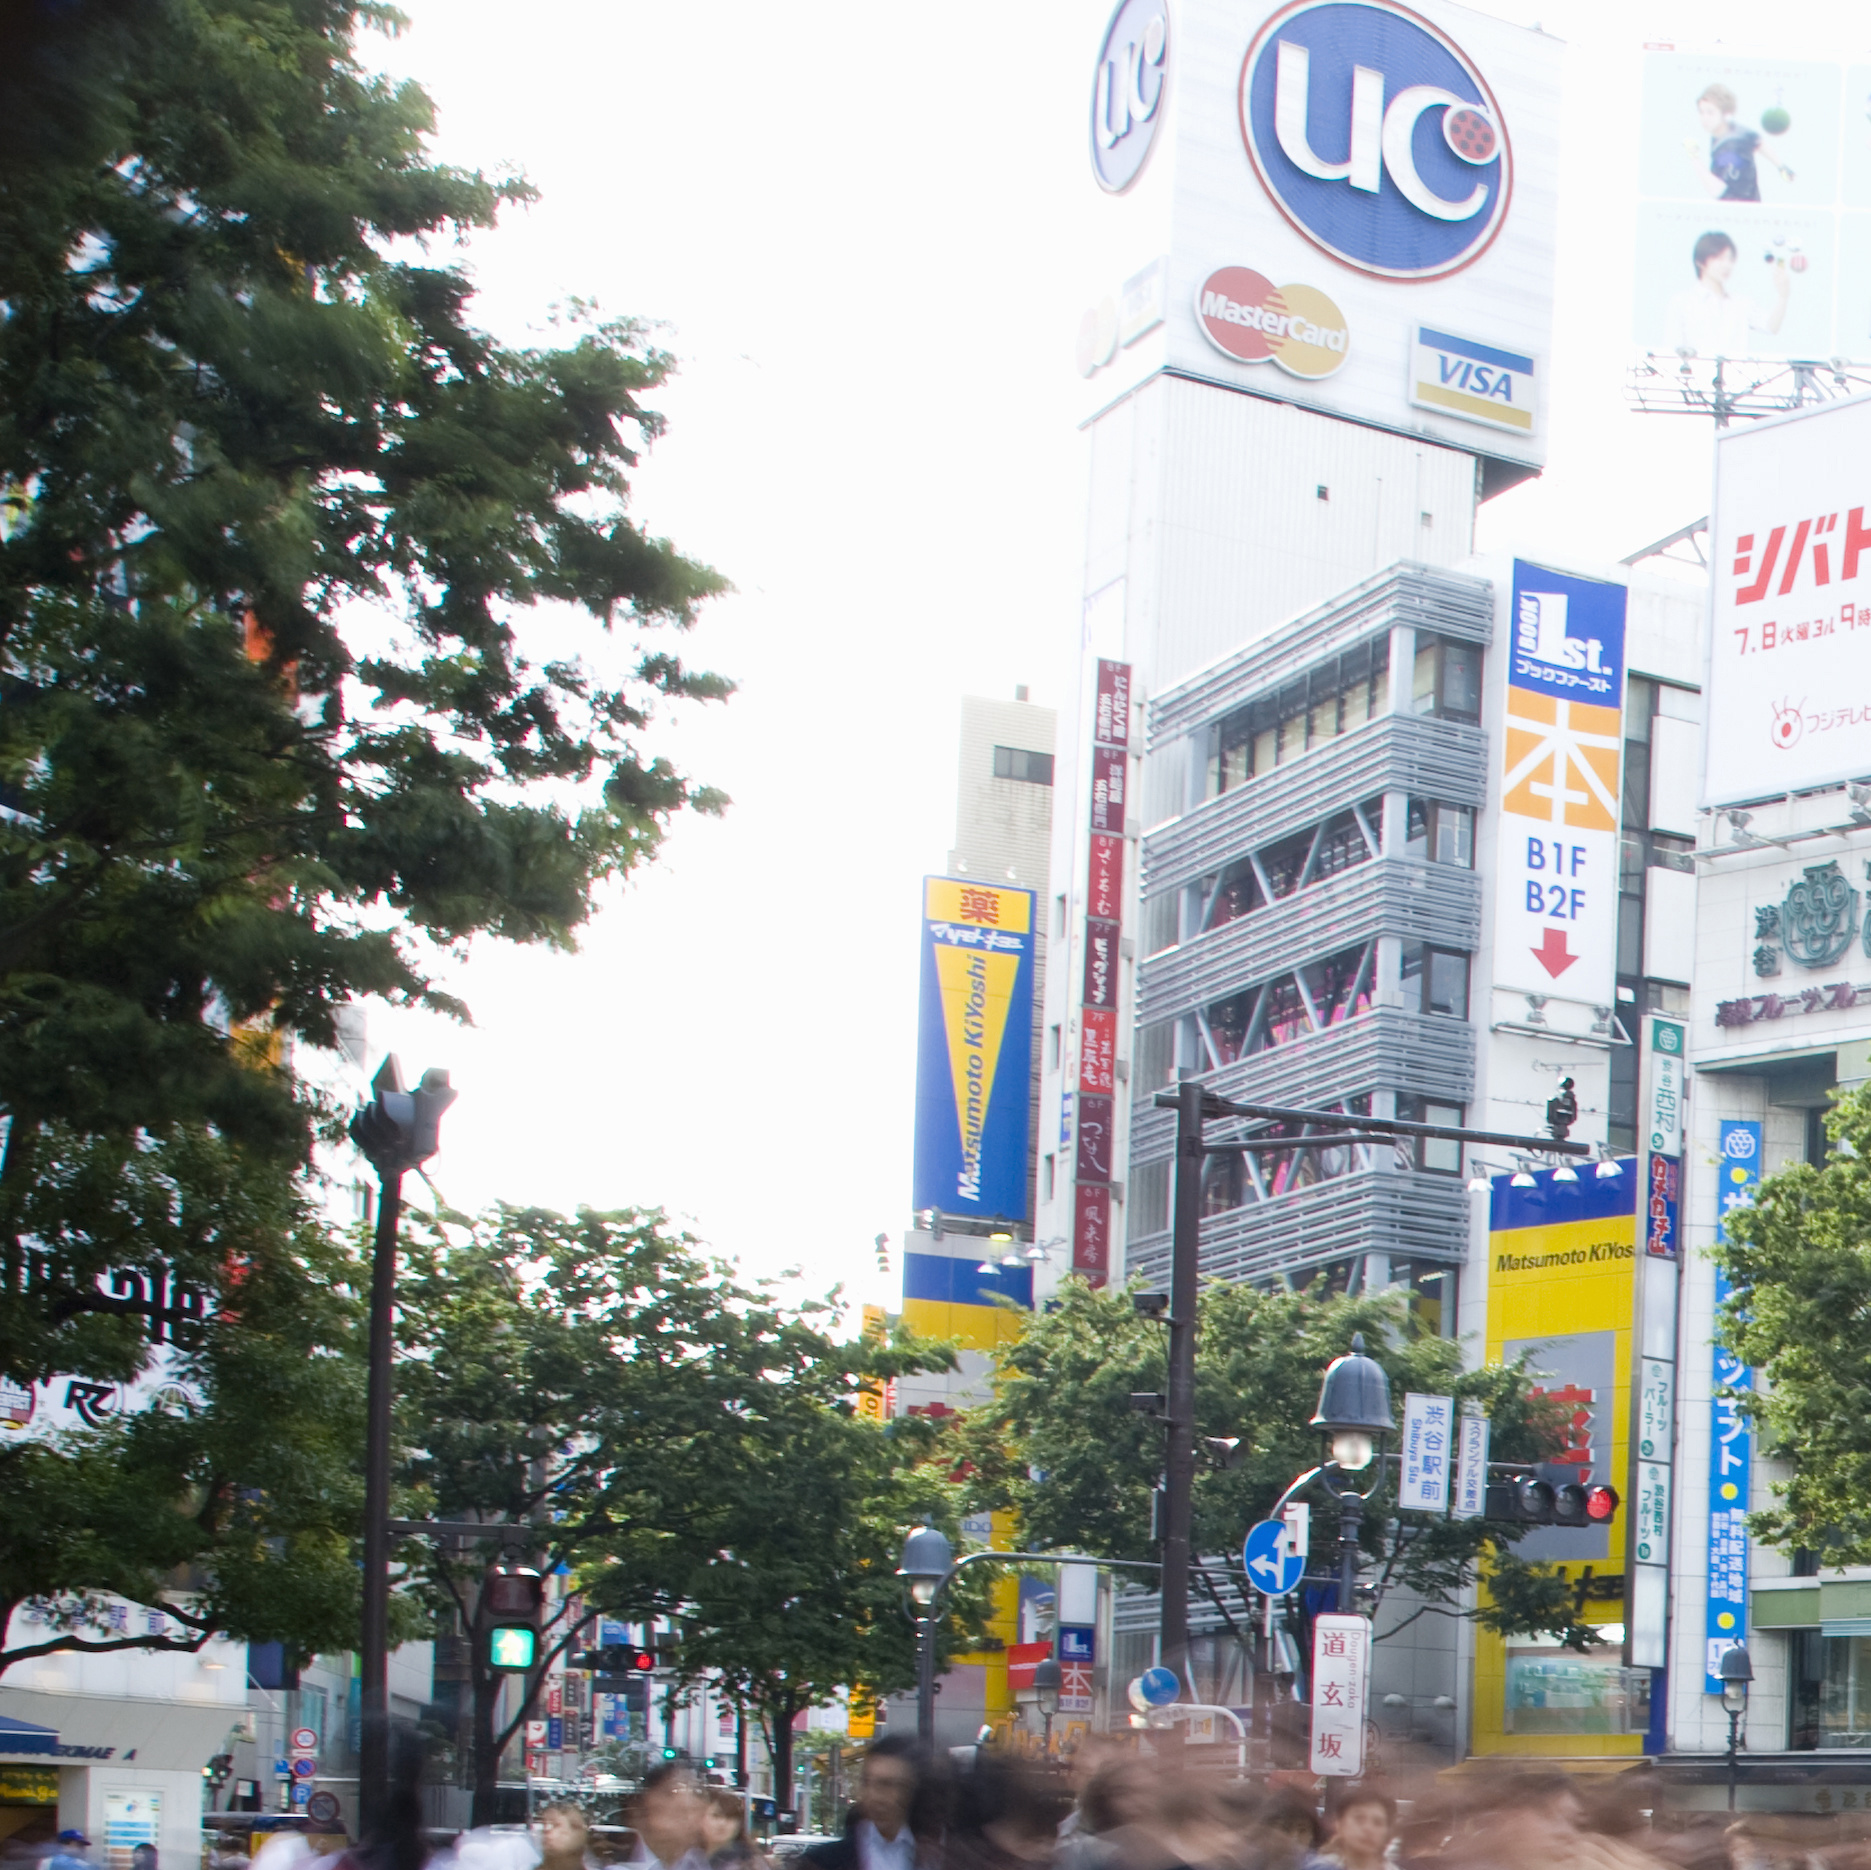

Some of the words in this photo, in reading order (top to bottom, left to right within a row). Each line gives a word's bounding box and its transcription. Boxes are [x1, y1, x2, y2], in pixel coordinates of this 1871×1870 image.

[1100, 15, 1166, 150] UC
[1274, 39, 1501, 222] UC
[1200, 290, 1348, 354] MasterCard
[1437, 354, 1514, 402] VISA
[1518, 594, 1538, 651] BOOK
[1527, 593, 1613, 676] 1st.
[1515, 659, 1613, 694] ブックファースト
[1503, 698, 1619, 828] 本
[1527, 836, 1588, 878] B1F
[959, 887, 1000, 924] 薬
[1526, 879, 1587, 921] B2F
[929, 923, 1024, 950] マツモトキヨシ
[963, 953, 987, 1049] KiYoshi
[1496, 1247, 1587, 1273] Matsumoto
[1644, 1387, 1656, 1437] パーラー
[1657, 1381, 1668, 1432] フルーツ
[1408, 1418, 1423, 1462] Shibuya
[1421, 1405, 1445, 1501] 渋谷駅前
[1641, 1489, 1652, 1540] フルーツ
[1318, 1631, 1347, 1759] 道玄坂
[1345, 1631, 1361, 1709] Dougen-zaka
